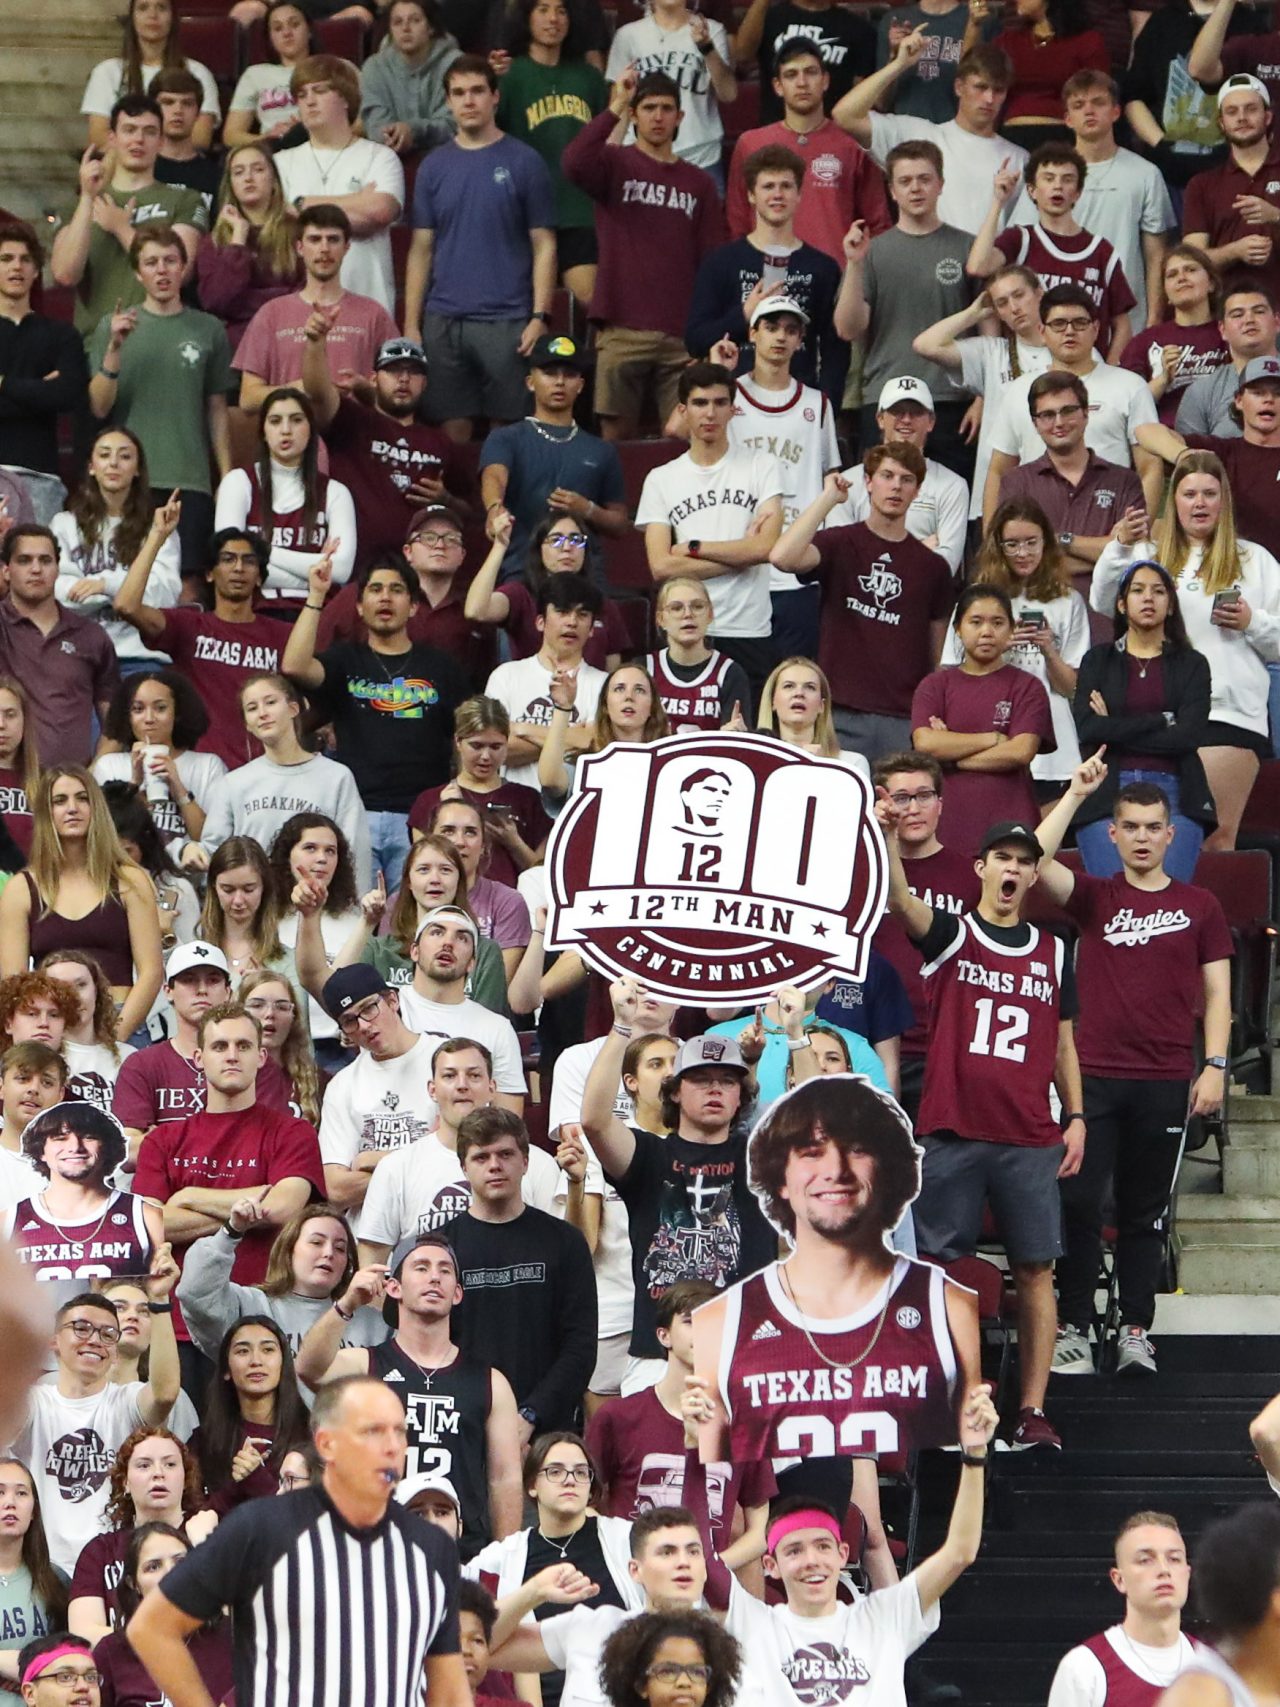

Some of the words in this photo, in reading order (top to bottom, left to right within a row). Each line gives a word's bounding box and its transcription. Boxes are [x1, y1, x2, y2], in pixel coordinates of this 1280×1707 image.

[623, 178, 666, 207] TEXAS
[371, 440, 410, 463] EXAS
[670, 489, 717, 527] TEXAS
[720, 489, 759, 514] A&M
[846, 596, 877, 619] TEXAS
[877, 606, 901, 625] A&M
[195, 634, 242, 667] TEXAS
[244, 642, 279, 672] A&M
[585, 751, 862, 911] 100
[677, 842, 722, 883] 12
[628, 894, 700, 921] 12TH
[712, 898, 795, 935] MAN
[1103, 908, 1192, 947] Aggies
[615, 935, 796, 981] CENTENNIAL
[956, 958, 1015, 995] TEXAS
[1019, 974, 1054, 1006] A&M
[968, 997, 1031, 1064] 12
[155, 1087, 207, 1110] TEX
[372, 1117, 410, 1132] ROCK
[173, 1156, 217, 1168] TEXAS
[15, 1243, 84, 1264] TEXAS
[89, 1241, 132, 1259] A&M
[752, 1329, 782, 1341] adidas
[742, 1367, 853, 1408] TEXAS
[862, 1364, 928, 1399] A&M
